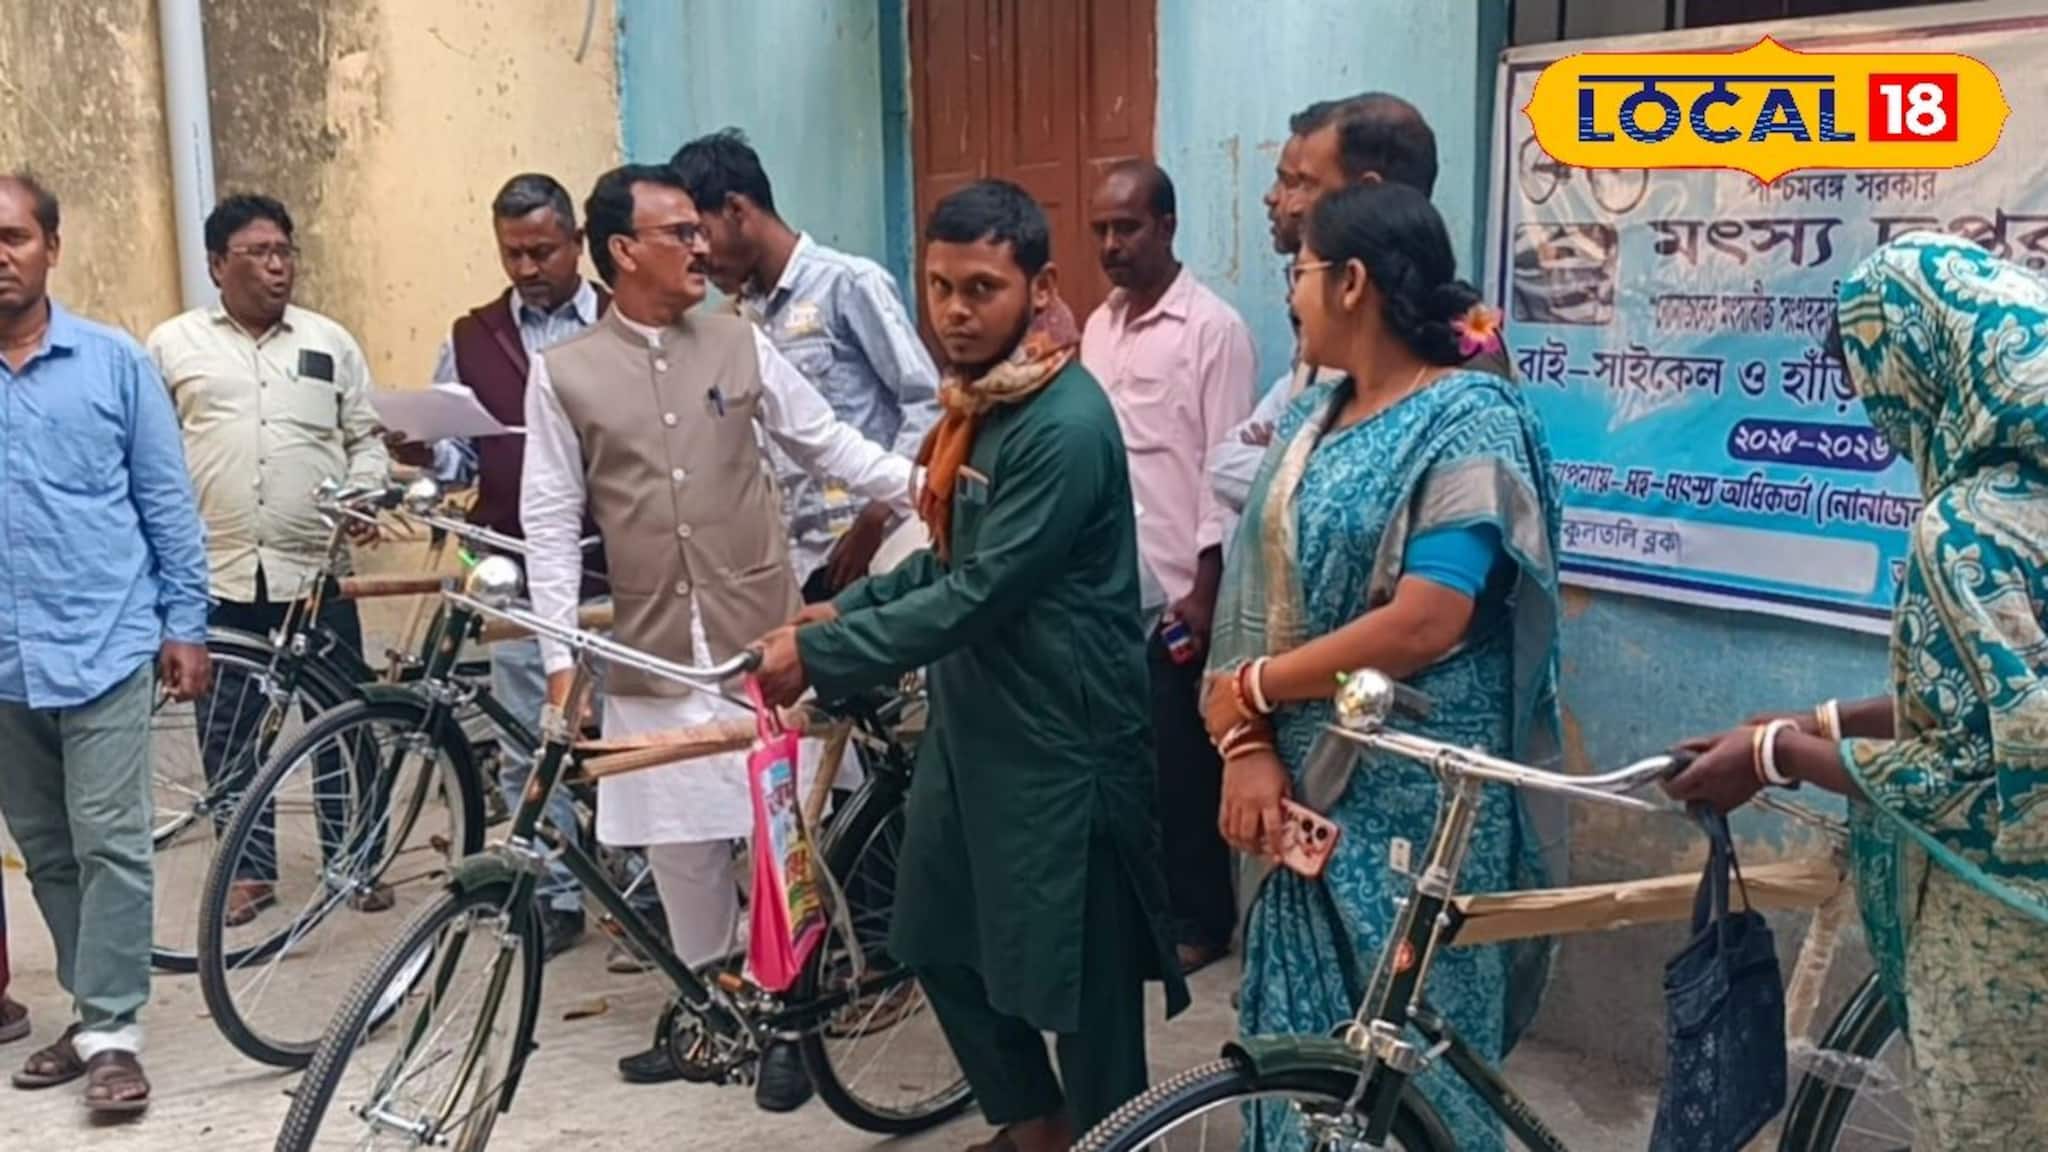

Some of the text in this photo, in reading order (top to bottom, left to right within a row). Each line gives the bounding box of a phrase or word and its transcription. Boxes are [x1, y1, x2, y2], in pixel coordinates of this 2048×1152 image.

[1856, 171, 1937, 200] সরকার
[1648, 217, 1842, 267] মৎস্য
[1738, 361, 1767, 395] ও
[1735, 425, 1889, 463] ২০২৫-২০২৬
[1720, 471, 1813, 515] অধিকর্তা
